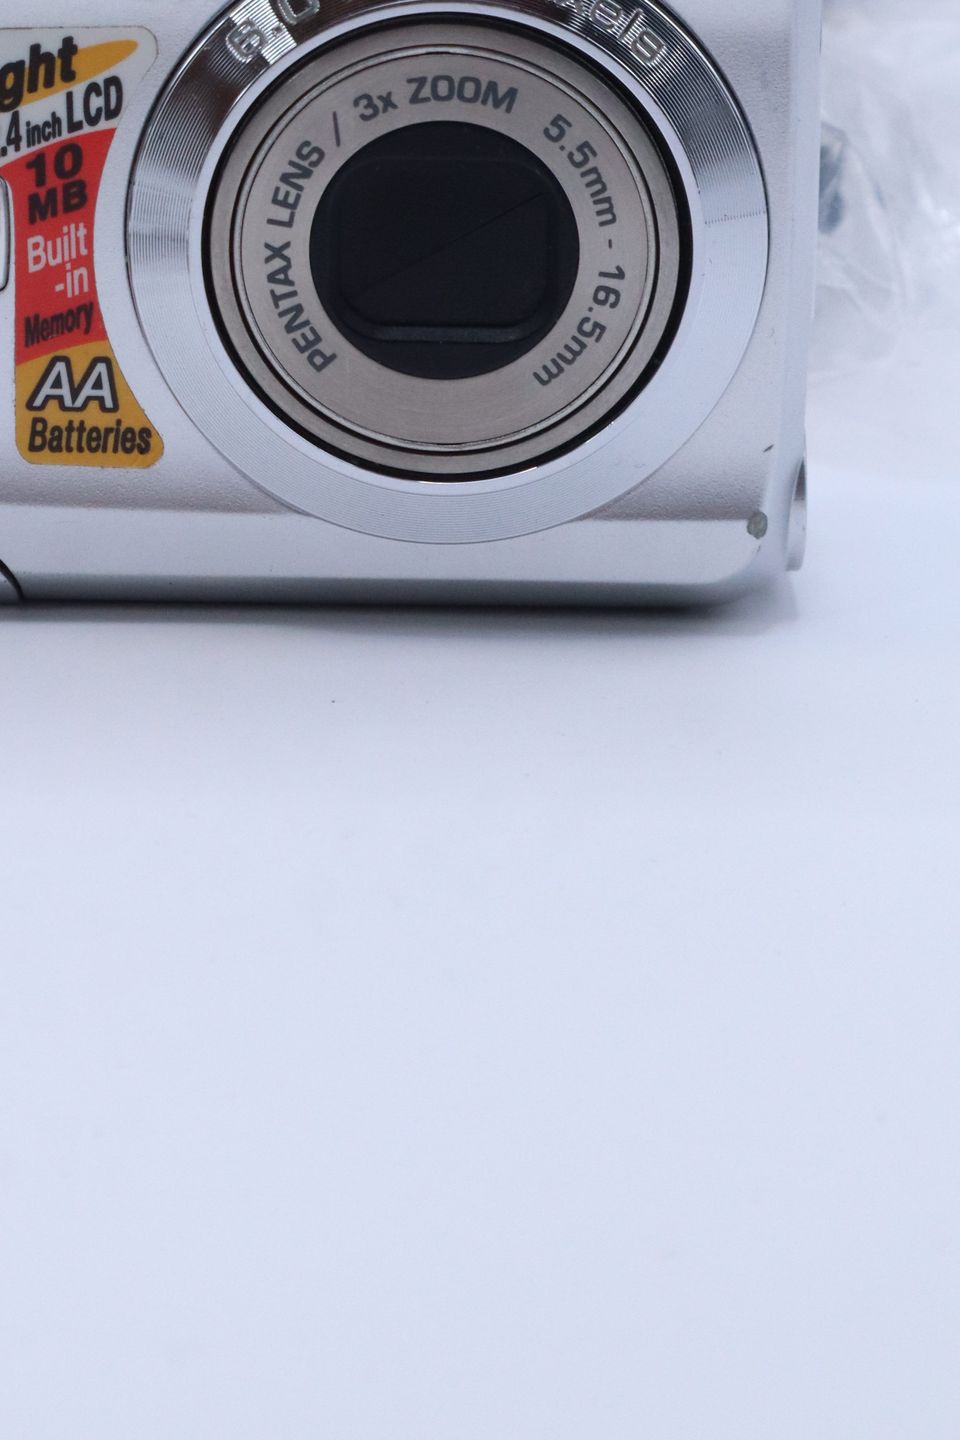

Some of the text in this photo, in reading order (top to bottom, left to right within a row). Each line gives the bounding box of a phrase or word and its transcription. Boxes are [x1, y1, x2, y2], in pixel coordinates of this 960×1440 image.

[26, 112, 63, 148] inch
[66, 76, 124, 134] LCD
[353, 91, 399, 123] 3x
[406, 74, 519, 114] ZOOM
[26, 143, 84, 187] 10
[268, 139, 326, 229] LENS
[542, 113, 618, 229] 5.5mm
[27, 180, 88, 225] MB
[27, 222, 88, 273] Built
[54, 264, 90, 300] -in
[24, 302, 94, 348] Memory
[263, 241, 338, 374] PENTAX
[532, 264, 627, 388] 16.5mm
[25, 355, 120, 414] AA
[27, 417, 152, 455] Batteries
